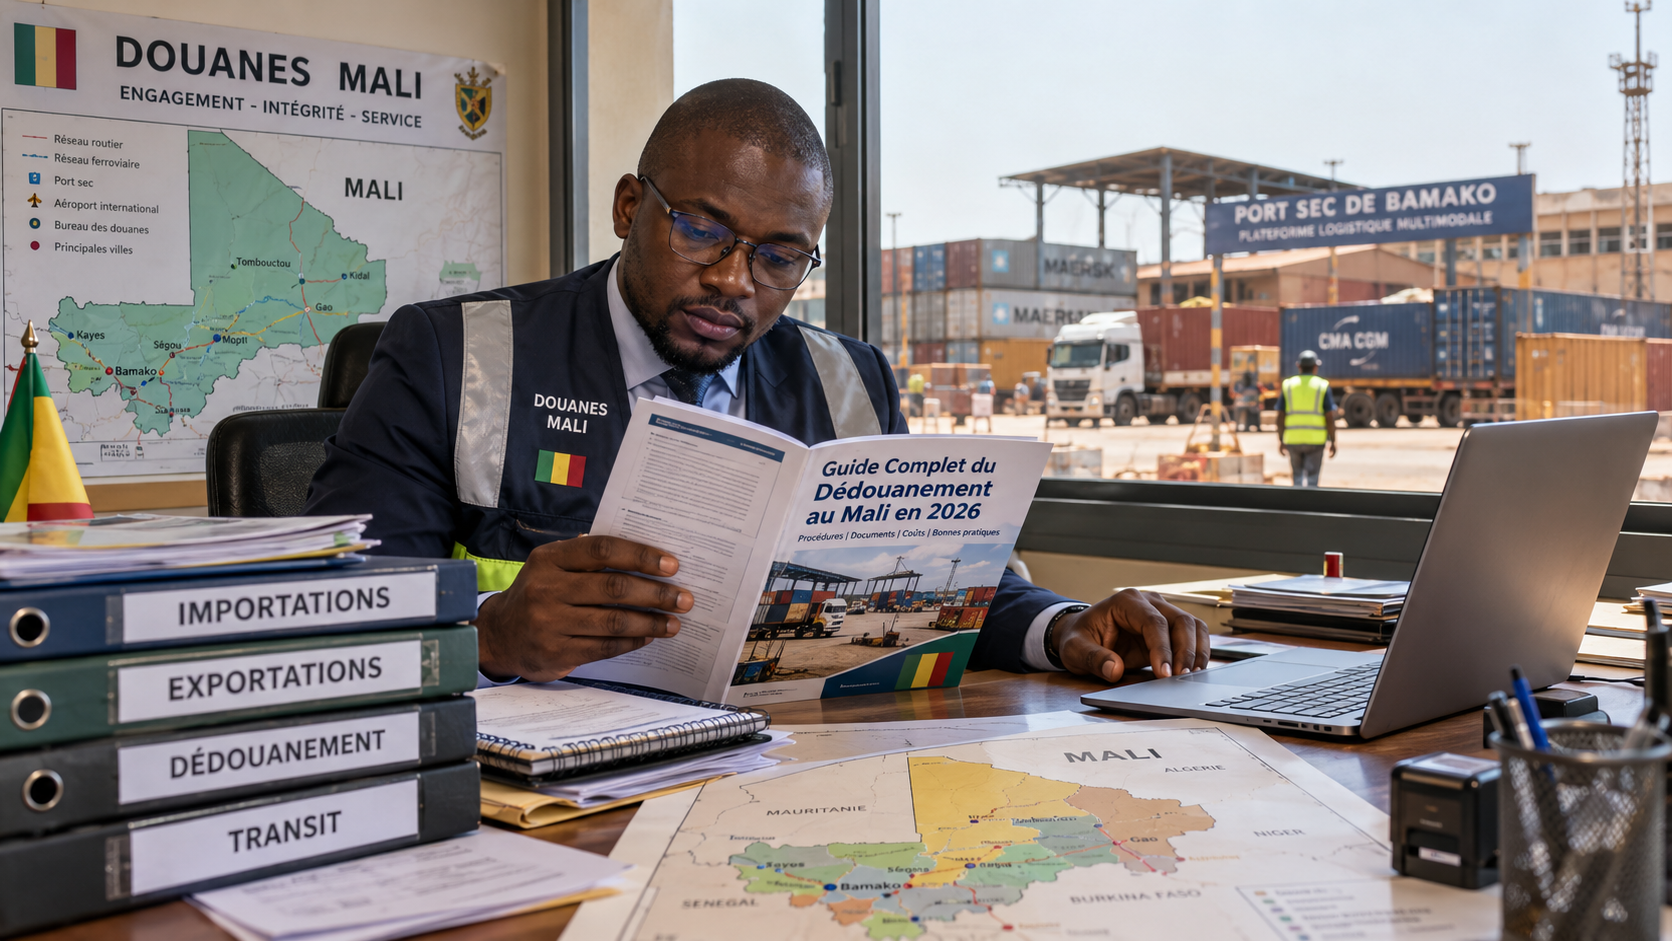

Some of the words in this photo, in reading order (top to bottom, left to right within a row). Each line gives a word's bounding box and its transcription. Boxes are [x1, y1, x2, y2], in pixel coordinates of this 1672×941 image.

[116, 34, 311, 87] DOUANES
[339, 61, 422, 99] MALI
[120, 85, 244, 111] ENGAGEMENT
[263, 100, 345, 121] INTÉGRITÉ
[361, 109, 422, 129] SERVICE
[54, 134, 89, 147] Réseau
[91, 139, 123, 149] routier
[54, 153, 89, 165] Réseau
[91, 156, 140, 169] ferroviaire
[54, 175, 75, 186] Port
[78, 179, 94, 187] sec
[344, 176, 403, 201] MALI
[54, 198, 97, 211] Aéroport
[100, 201, 159, 214] international
[1234, 202, 1289, 224] PORT
[1296, 197, 1337, 219] SEC
[1345, 194, 1376, 215] DE
[1386, 183, 1497, 212] BAMAKO
[54, 220, 89, 231] Bureau
[91, 222, 108, 233] des
[110, 223, 149, 235] douanes
[1239, 224, 1315, 242] PLATEFORME
[1318, 218, 1393, 237] LOGISTIQUE
[1397, 211, 1493, 231] MULTIMODALE
[54, 242, 107, 255] Principales
[109, 245, 133, 255] villes
[349, 271, 370, 280] Kidal
[315, 303, 333, 312] Gao
[77, 331, 105, 341] Kayes
[1318, 332, 1352, 350] CMA
[1354, 331, 1389, 349] CGM
[115, 366, 157, 376] Bamako
[534, 393, 608, 416] DOUANES
[547, 415, 588, 434] MALI
[822, 458, 879, 477] Guide
[884, 456, 966, 477] Complet
[971, 457, 997, 474] du
[814, 479, 993, 502] Dédouanement
[805, 508, 835, 525] au
[840, 504, 890, 523] Mali
[894, 506, 921, 521] en
[926, 502, 982, 521] 2026
[798, 531, 844, 543] Procédures
[850, 529, 896, 540] Documents
[902, 528, 926, 538] Coûts
[932, 528, 961, 537] Bonnes
[962, 527, 1001, 539] pratiques
[178, 586, 391, 627] IMPORTATIONS
[168, 656, 382, 701] EXPORTATIONS
[170, 729, 386, 780] DÉDOUANEMENT
[1063, 748, 1163, 763] MALI
[1164, 765, 1226, 773] ALGERIE
[766, 804, 867, 816] MAURITANIE
[228, 810, 342, 853] TRANSIT
[1253, 829, 1306, 838] NIGER
[841, 881, 901, 891] Bamako
